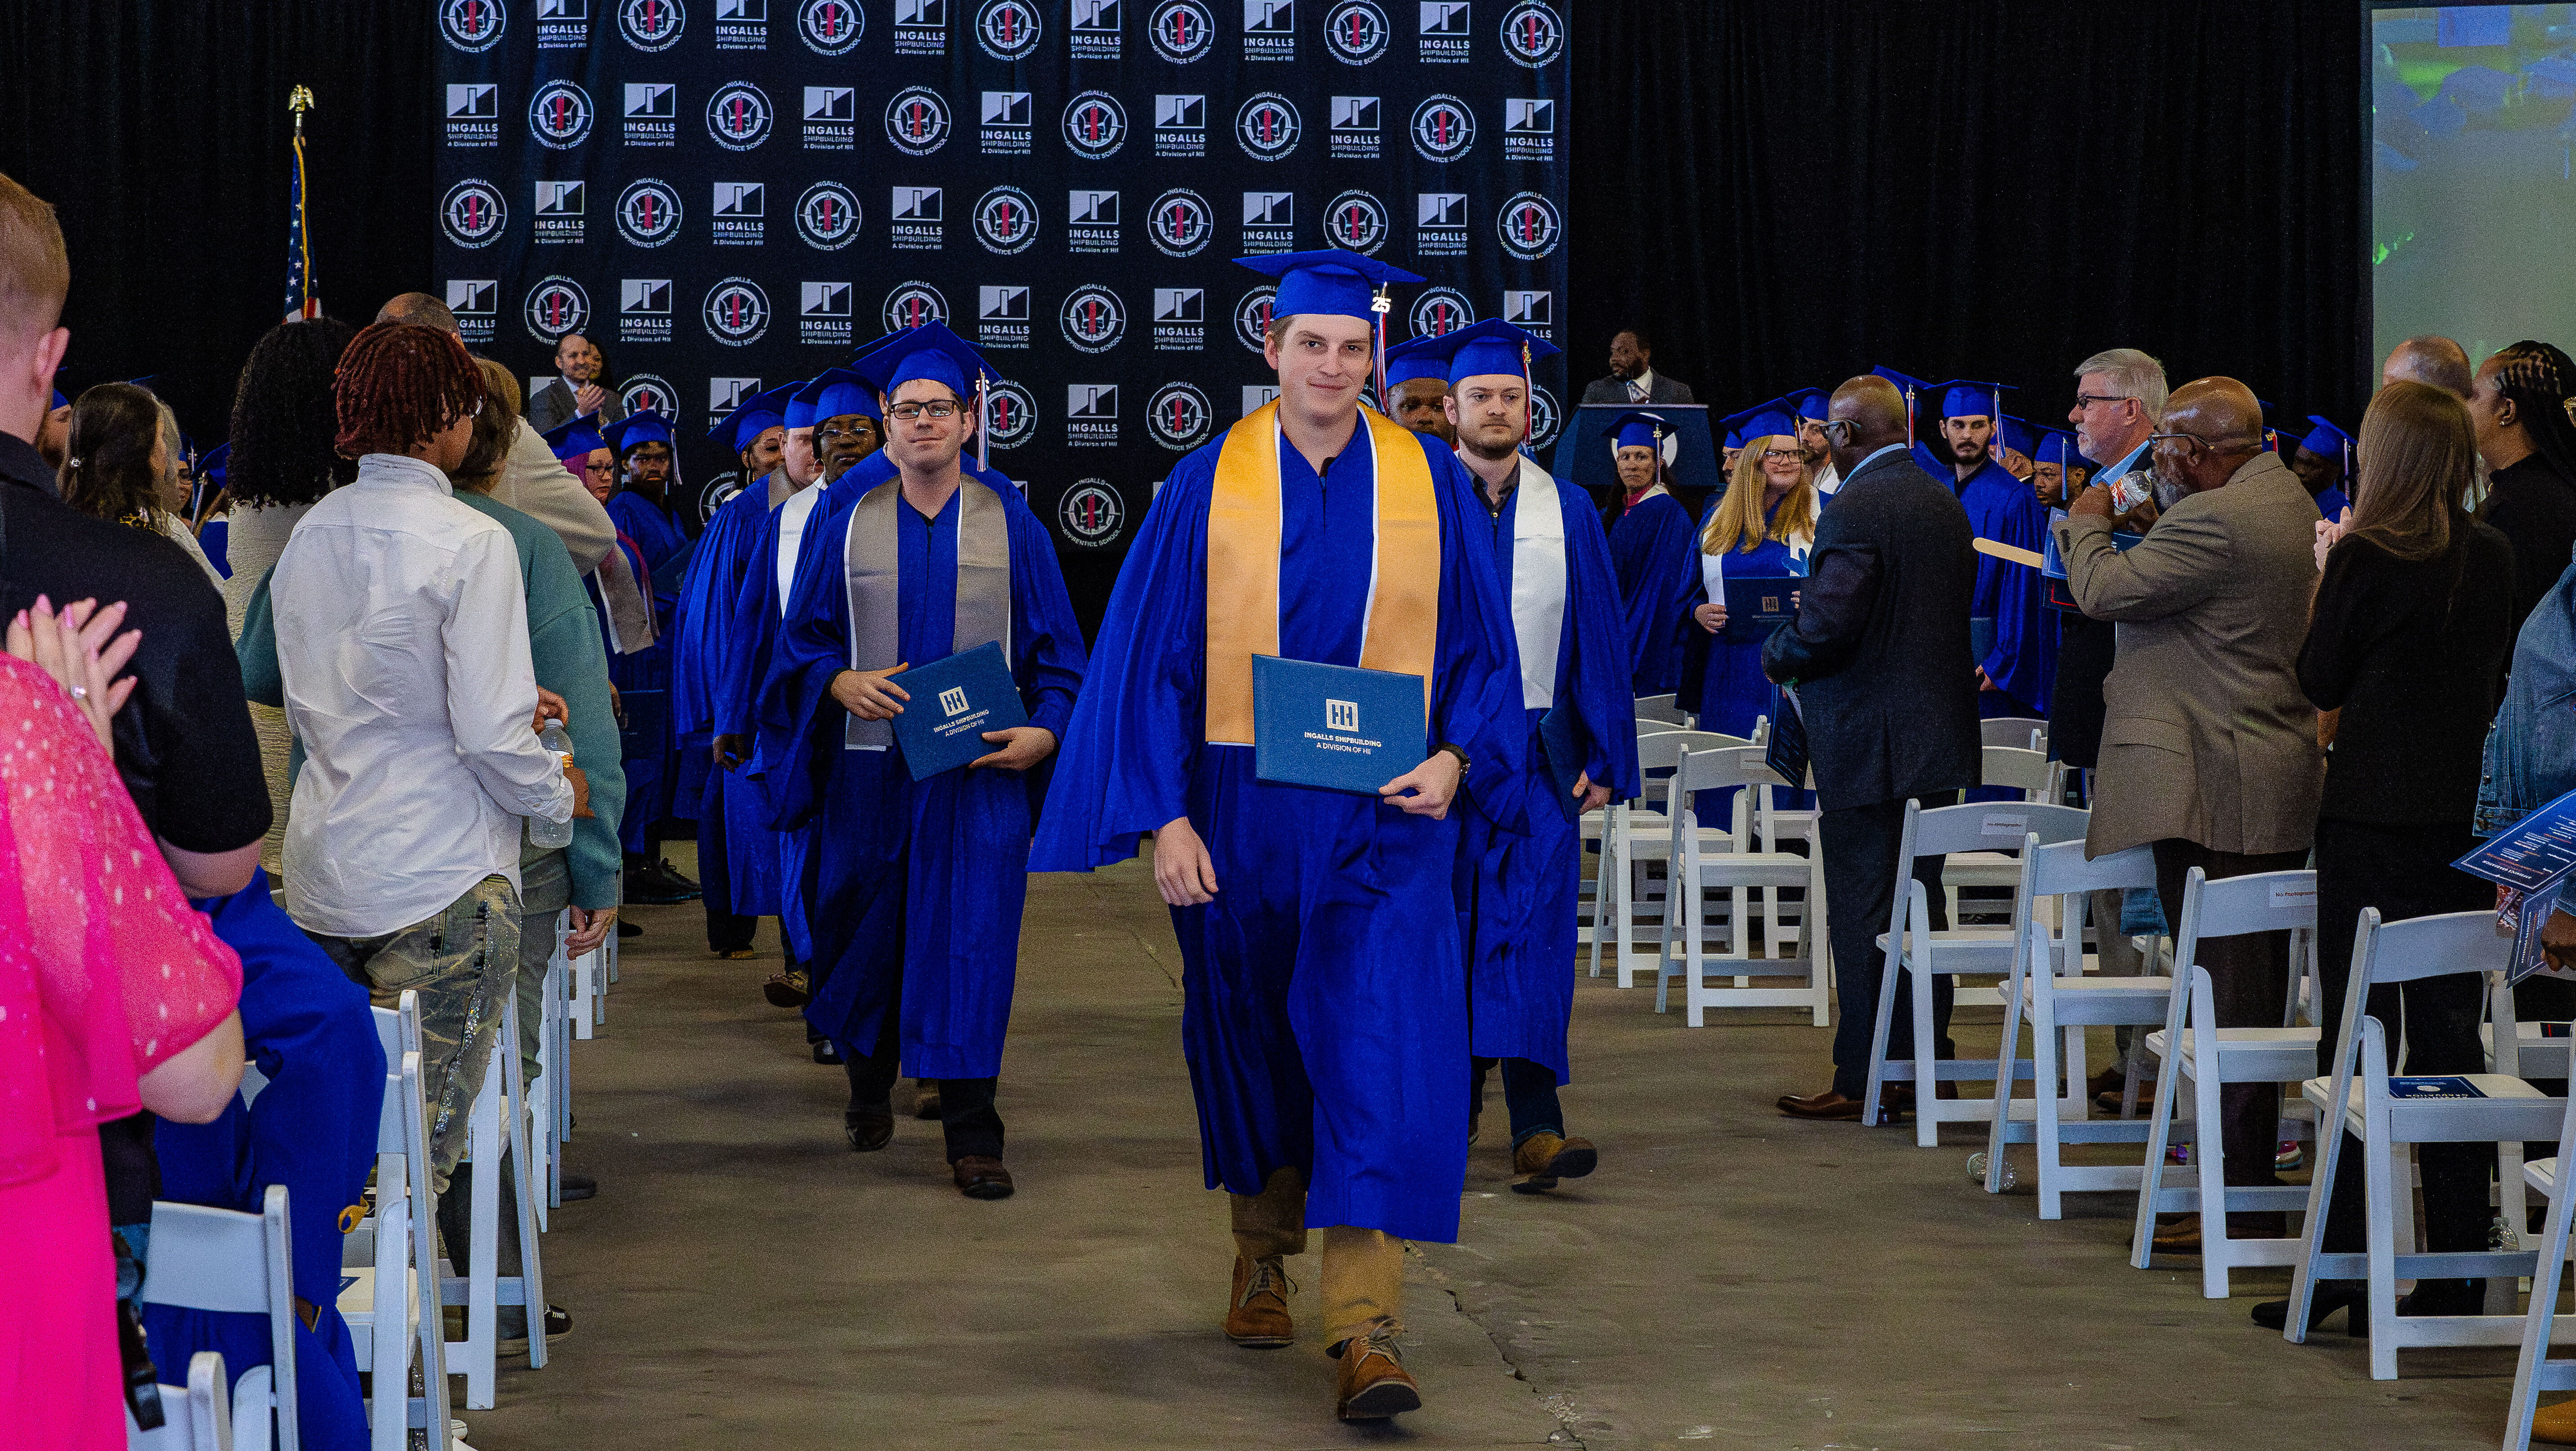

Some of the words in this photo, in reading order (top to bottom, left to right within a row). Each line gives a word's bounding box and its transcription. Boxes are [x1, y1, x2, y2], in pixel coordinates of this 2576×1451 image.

[537, 25, 587, 34] INGALLS
[716, 26, 767, 36] INGALLS
[895, 31, 945, 40] INGALLS
[1071, 36, 1121, 45] INGALLS
[1244, 38, 1294, 47] INGALLS
[1420, 40, 1469, 49] INGALLS
[447, 124, 498, 132] INGALLS
[624, 123, 675, 132] INGALLS
[804, 125, 854, 135] INGALLS
[981, 131, 1031, 140] INGALLS
[1156, 134, 1205, 143] INGALLS
[1331, 135, 1380, 144] INGALLS
[1505, 137, 1553, 147] INGALLS
[535, 221, 584, 229] INGALLS
[713, 222, 763, 231] INGALLS
[893, 225, 942, 235] INGALLS
[1069, 230, 1119, 238] INGALLS
[1243, 232, 1293, 240] INGALLS
[1371, 297, 1391, 313] 25
[459, 319, 496, 328] GALLS
[620, 319, 671, 327] INGALLS
[801, 321, 851, 330] INGALLS
[979, 325, 1029, 335] INGALLS
[1154, 327, 1204, 335] INGALLS
[933, 722, 955, 732] INGALLS
[955, 709, 989, 725] SHIPBUILDING
[949, 723, 970, 735] DIVISION
[1304, 732, 1334, 741] INGALLS
[1335, 736, 1382, 747] SHIPBUILDING
[1323, 742, 1351, 752] DIVISION
